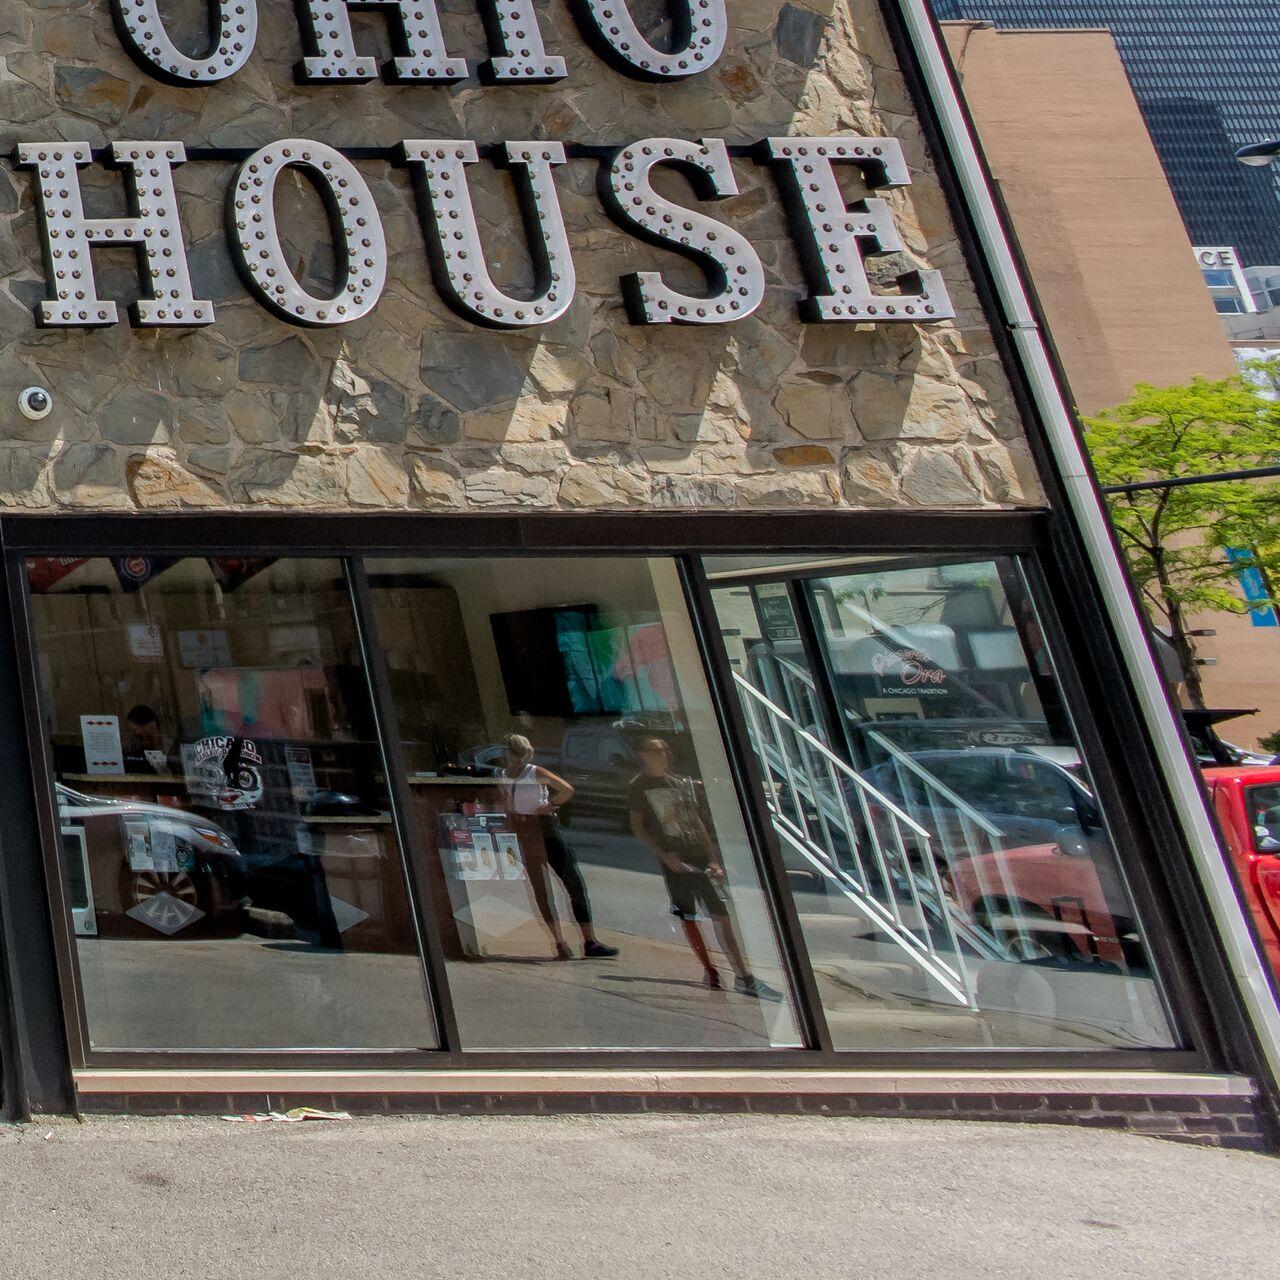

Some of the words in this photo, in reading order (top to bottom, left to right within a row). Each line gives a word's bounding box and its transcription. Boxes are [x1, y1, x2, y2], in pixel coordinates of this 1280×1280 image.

[16, 137, 955, 328] HOUSE
[1199, 250, 1234, 267] CE
[888, 687, 917, 695] CHICAGO
[917, 687, 949, 695] TRADITION
[194, 736, 257, 755] CHICAO
